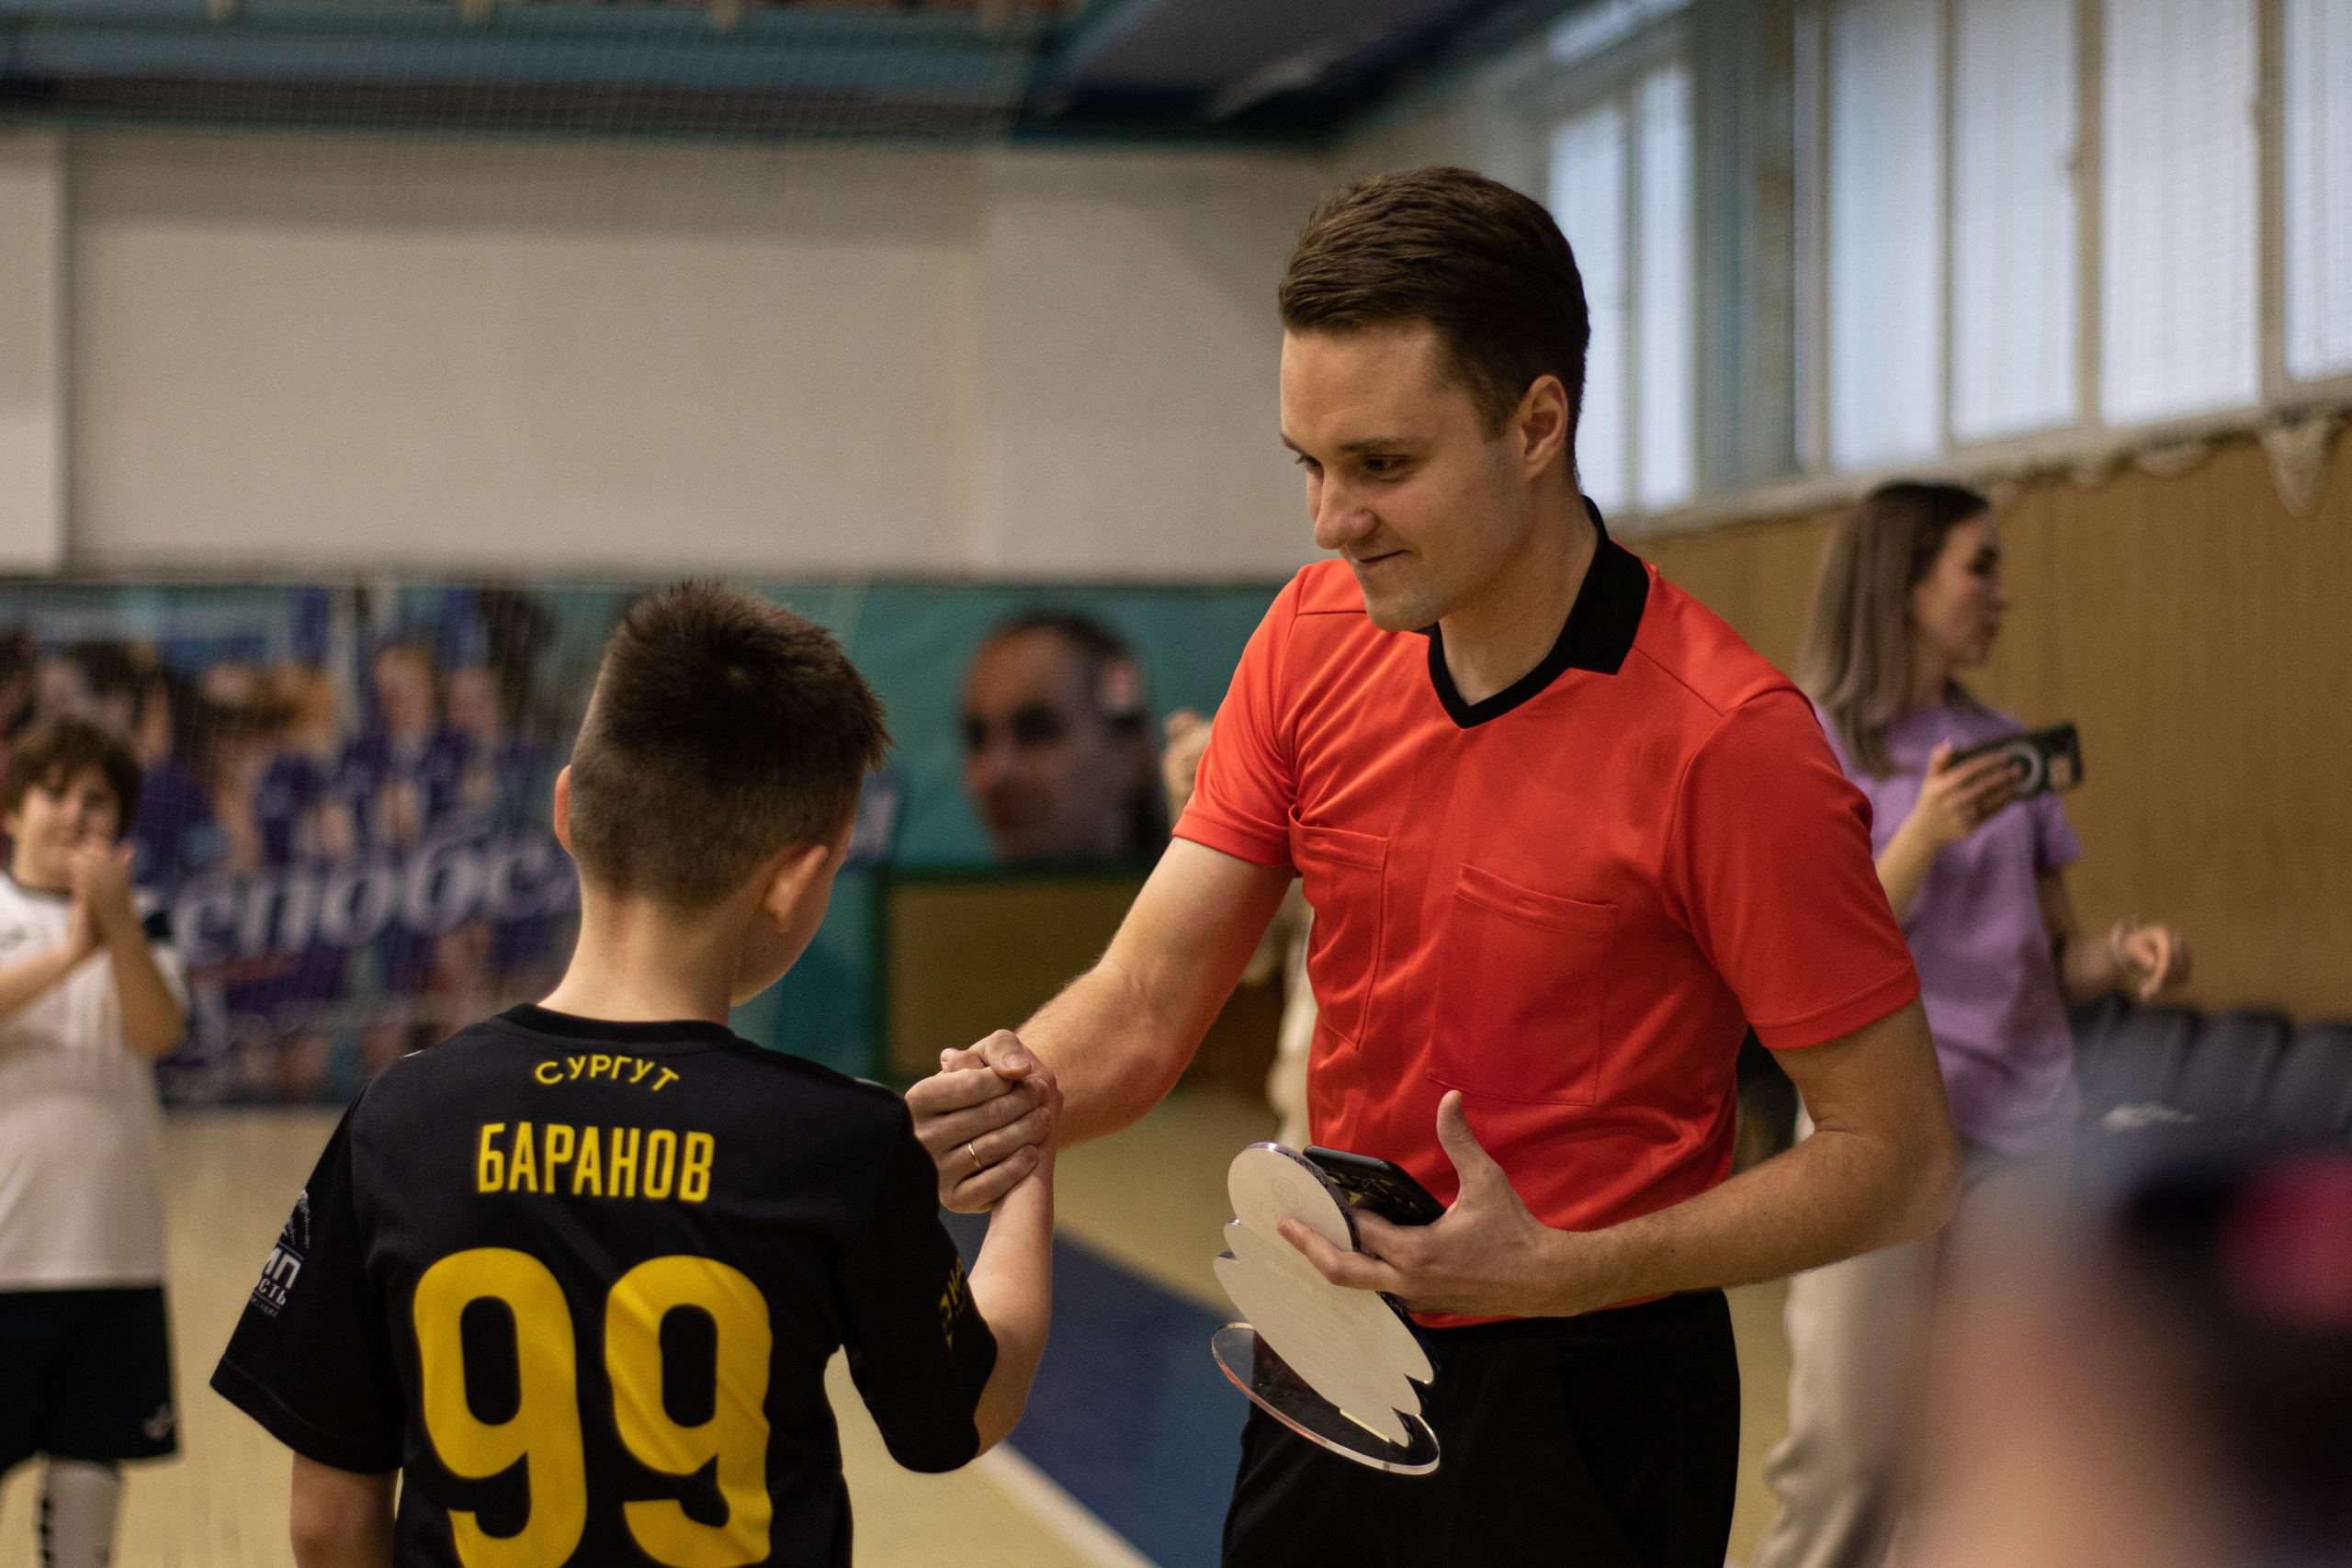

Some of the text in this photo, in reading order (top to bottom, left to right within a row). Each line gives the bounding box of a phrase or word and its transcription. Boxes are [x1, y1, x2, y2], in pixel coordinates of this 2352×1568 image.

[534, 1054, 681, 1091] СУРГУТ
[477, 1121, 716, 1203] БАРАНОВ
[258, 1278, 287, 1306] СТЬ
[413, 1246, 774, 1568] 99
